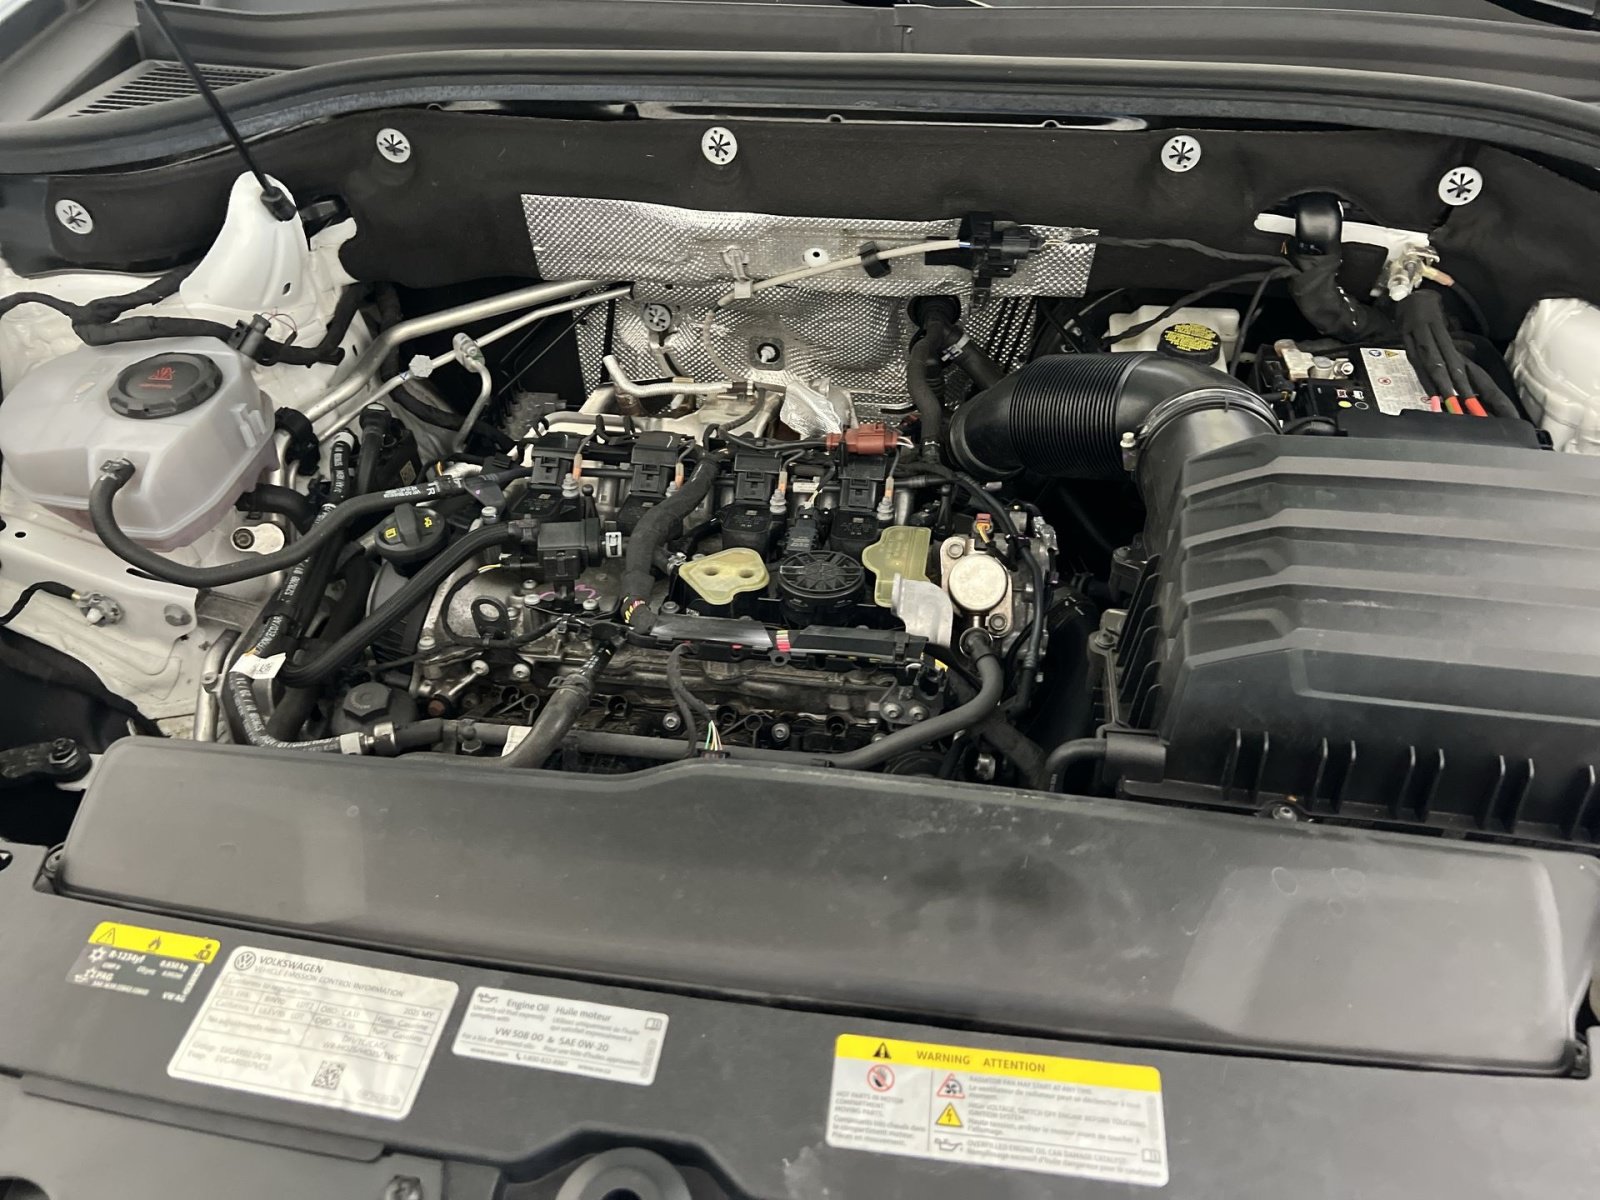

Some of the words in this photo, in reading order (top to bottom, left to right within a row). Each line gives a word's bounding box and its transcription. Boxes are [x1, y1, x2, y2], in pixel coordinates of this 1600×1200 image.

[259, 956, 325, 974] VOLKSWAGEN
[253, 966, 281, 974] VEHICLE
[284, 971, 318, 980] EMISSION
[318, 976, 351, 987] CONTROL
[352, 982, 404, 996] INFORMATION
[506, 998, 535, 1011] Engine
[536, 1003, 549, 1011] Oil
[555, 1006, 578, 1015] Huile
[579, 1010, 611, 1021] moteur
[494, 1027, 511, 1036] VW
[512, 1030, 529, 1039] 508
[530, 1033, 544, 1041] 00
[558, 1037, 576, 1046] SAE
[916, 1050, 969, 1064] WARNING
[983, 1057, 1045, 1072] ATTENTION
